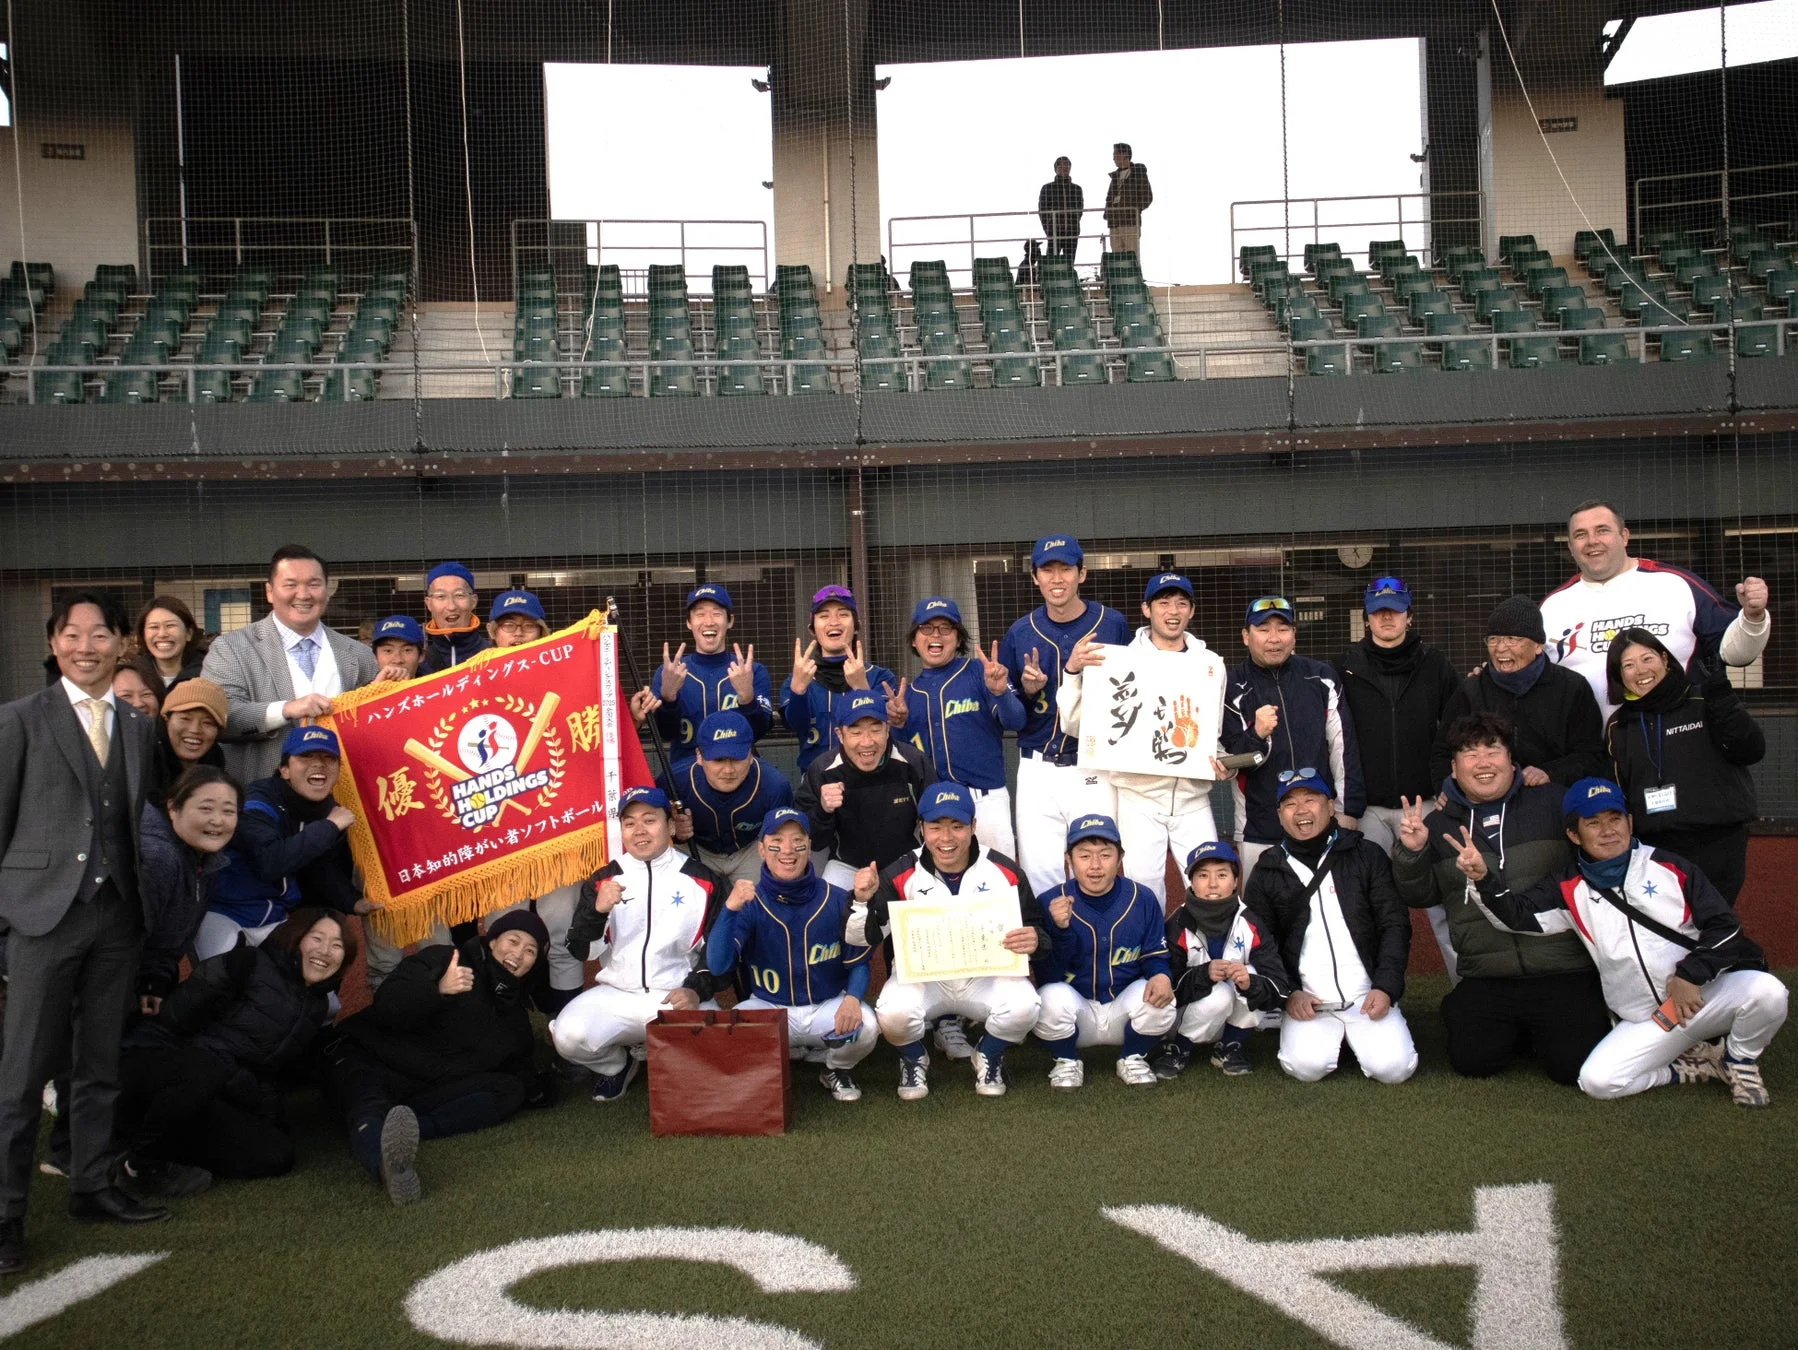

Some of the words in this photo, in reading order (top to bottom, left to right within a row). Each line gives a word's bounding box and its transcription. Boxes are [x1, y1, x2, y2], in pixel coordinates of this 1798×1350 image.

[1044, 540, 1066, 552] Chiba
[504, 596, 527, 607] Chiba
[1591, 614, 1644, 632] HANDS
[852, 697, 875, 709] Chiba
[945, 698, 980, 719] Chiba
[303, 731, 328, 741] Chiba
[566, 704, 600, 753] 勝
[680, 718, 694, 744] 9
[713, 728, 737, 741] Chiba
[1666, 720, 1704, 736] NITTAIDAI
[452, 765, 516, 799] HANDS
[376, 766, 425, 821] 優
[456, 770, 549, 814] HOLDINGS
[935, 792, 960, 804] Chiba
[1587, 785, 1611, 798] Chiba
[461, 804, 498, 827] CUP
[1080, 819, 1104, 830] Chiba
[398, 800, 603, 883] 日本知的障がい者ソフトボール
[751, 965, 780, 994] 10
